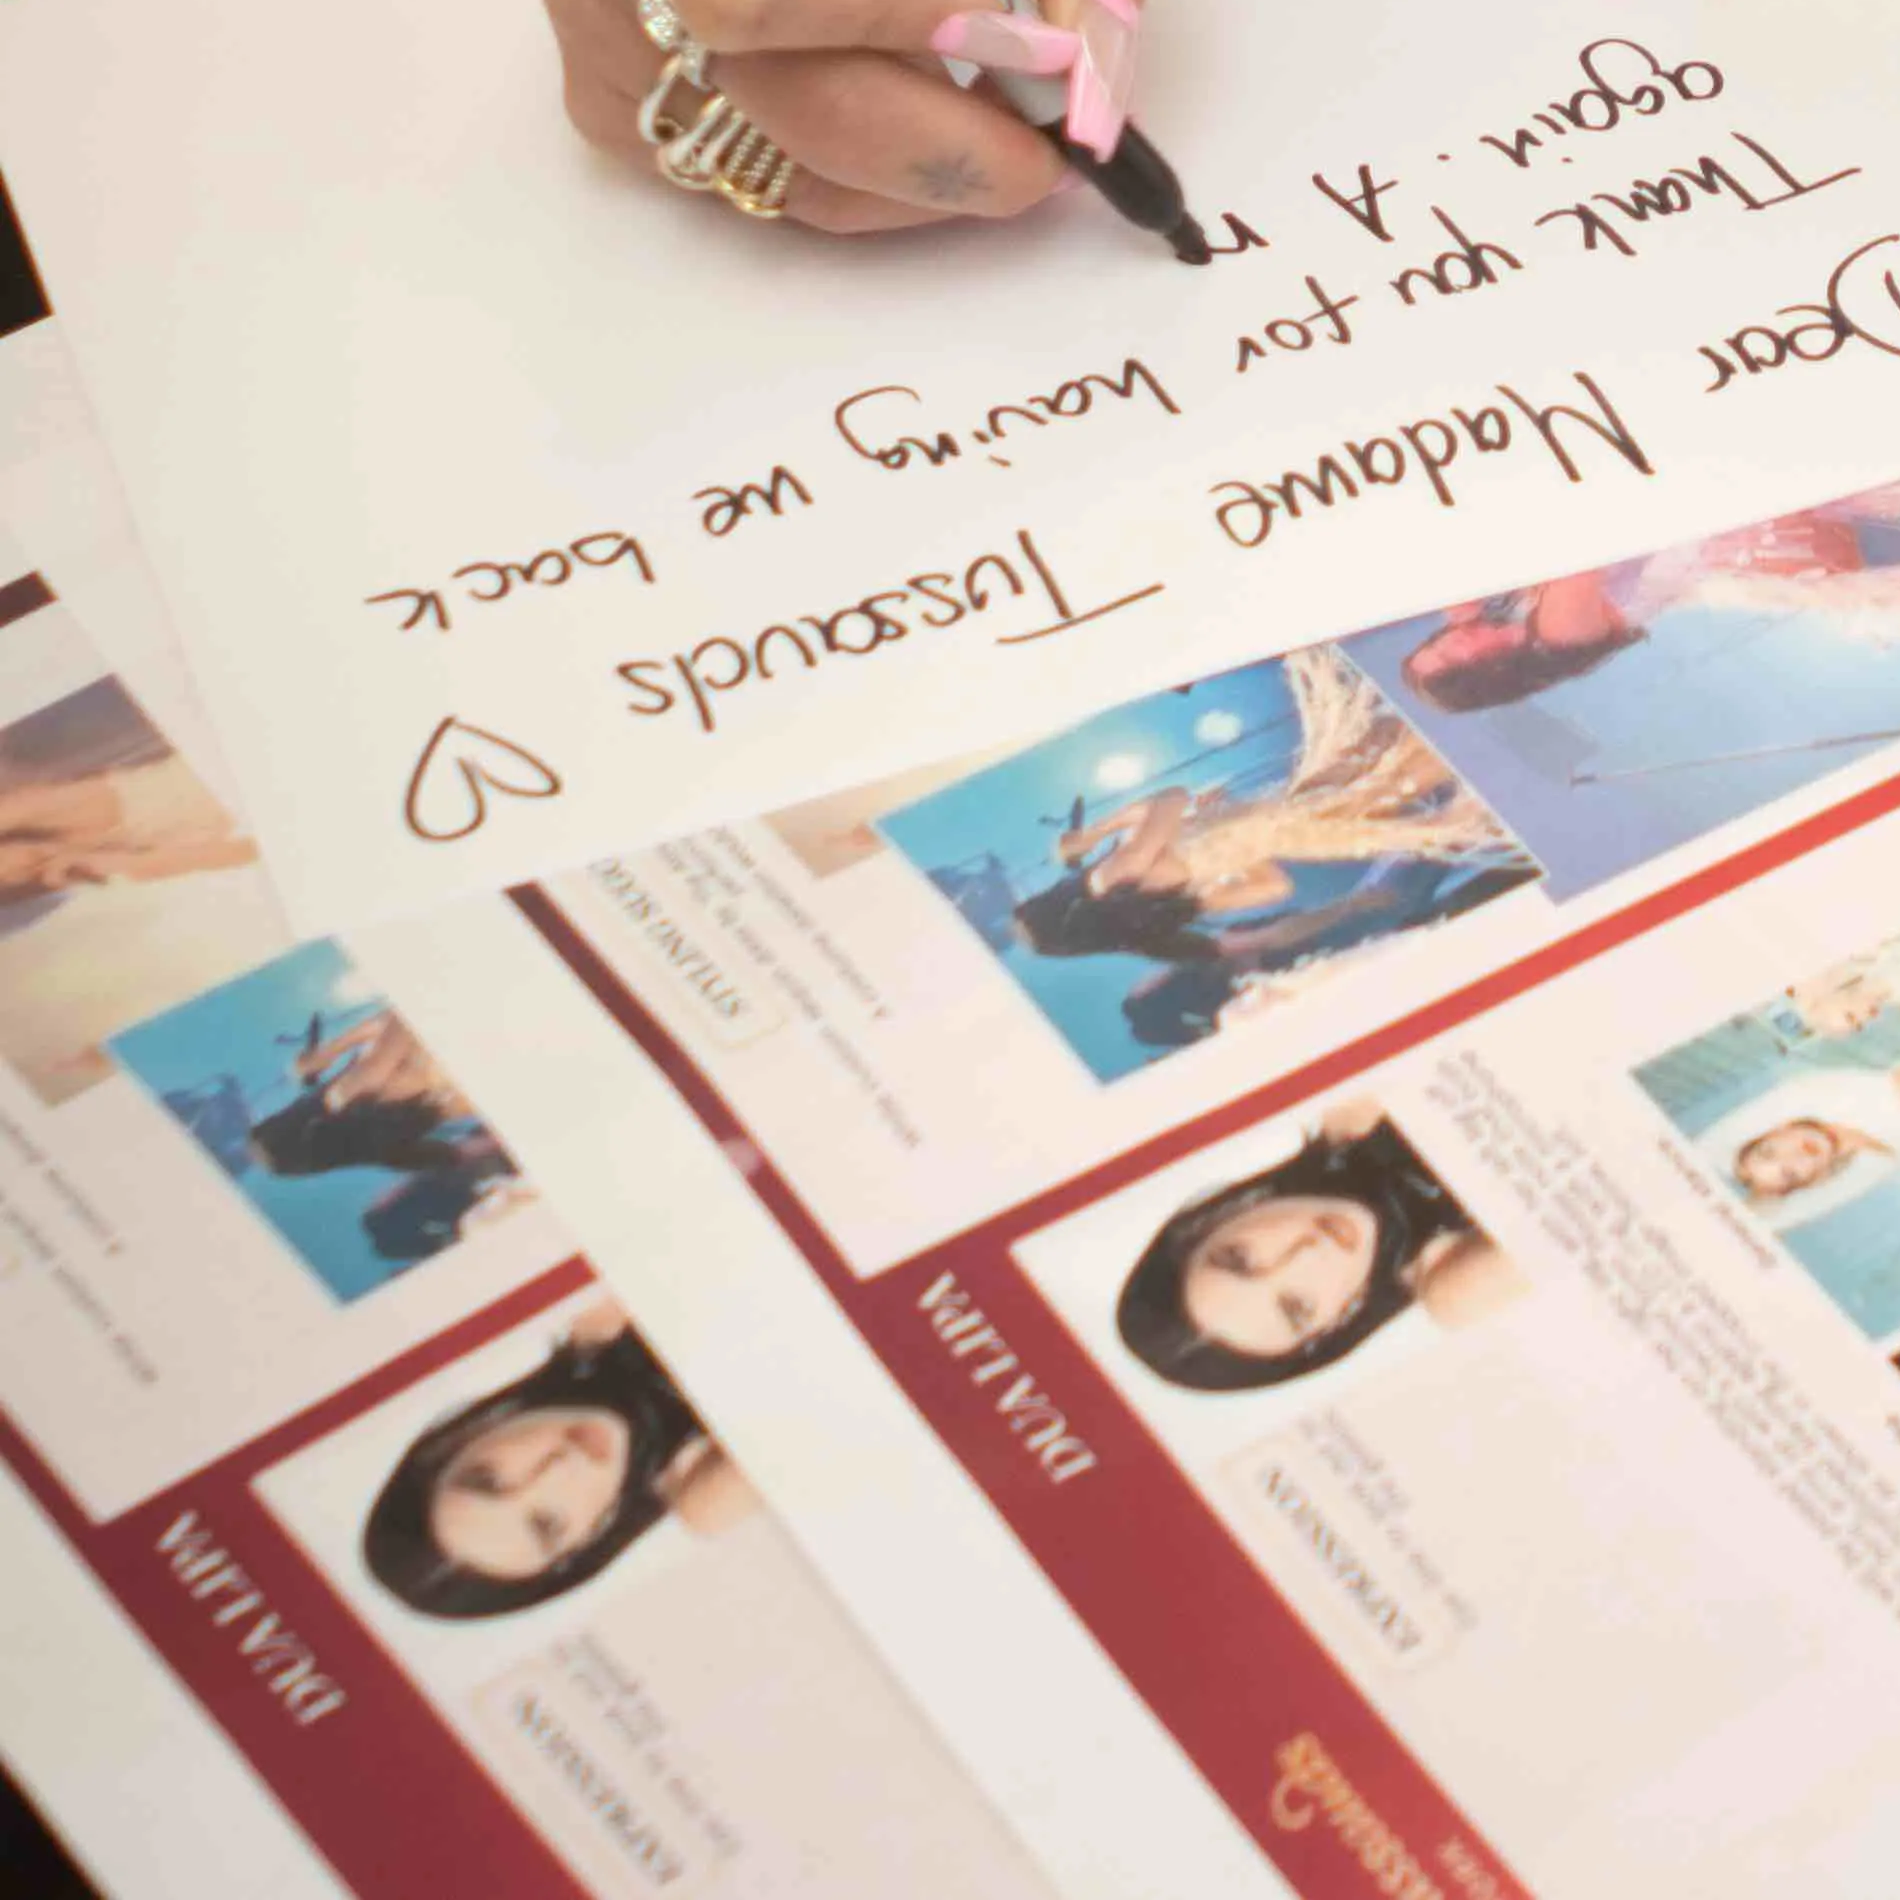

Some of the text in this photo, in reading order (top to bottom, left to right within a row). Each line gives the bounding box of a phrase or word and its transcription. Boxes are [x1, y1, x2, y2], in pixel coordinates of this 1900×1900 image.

[1360, 206, 1523, 305] you
[1535, 135, 1861, 257] Thank
[1236, 275, 1358, 373] for
[834, 358, 1181, 471] having
[1212, 372, 1655, 548] Madame
[366, 531, 655, 631] back
[615, 529, 1164, 733] Tussauds
[919, 1272, 1094, 1482] DUA LIPA
[159, 1513, 343, 1723] DUA LIPA
